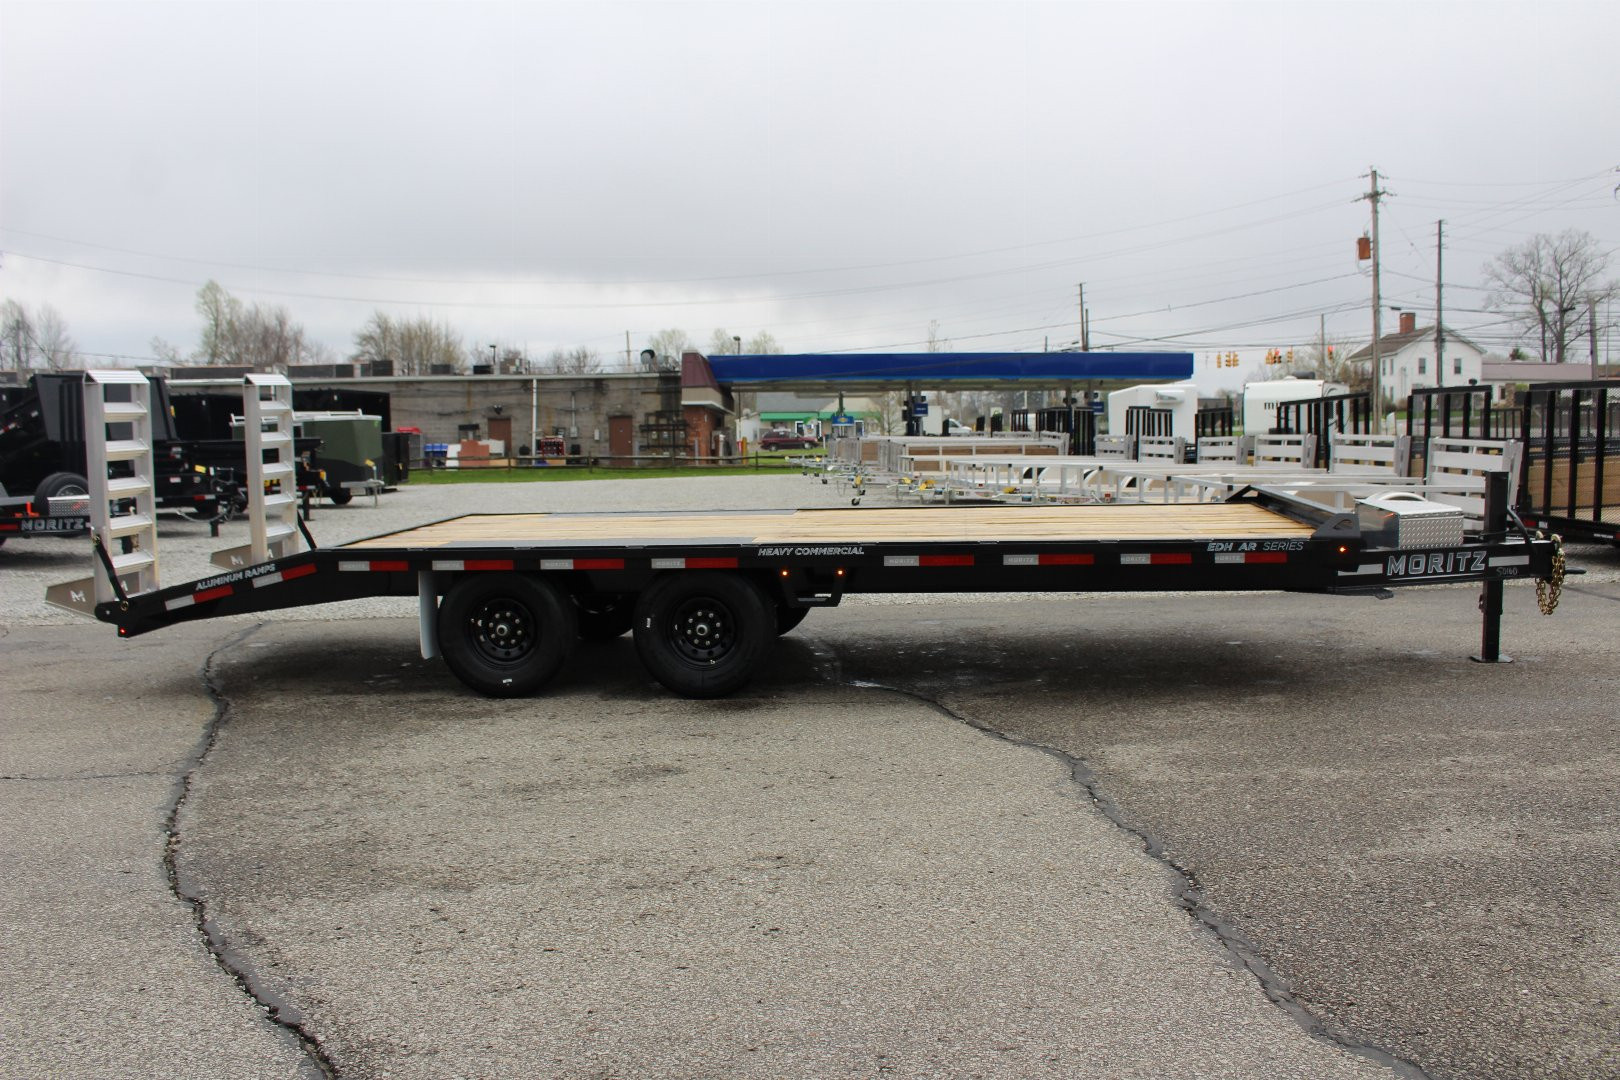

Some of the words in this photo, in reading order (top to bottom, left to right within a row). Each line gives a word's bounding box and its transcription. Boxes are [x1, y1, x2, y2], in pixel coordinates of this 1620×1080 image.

[21, 518, 84, 531] MORITZ
[758, 548, 793, 556] HEAVY
[794, 546, 865, 556] COMMERCIAL
[1207, 543, 1233, 552] EDH
[1238, 542, 1257, 551] AR
[1262, 541, 1304, 551] SERIES
[1387, 550, 1487, 576] MORITZ
[195, 571, 244, 591] ALUMINUM
[244, 563, 276, 579] RAMPS
